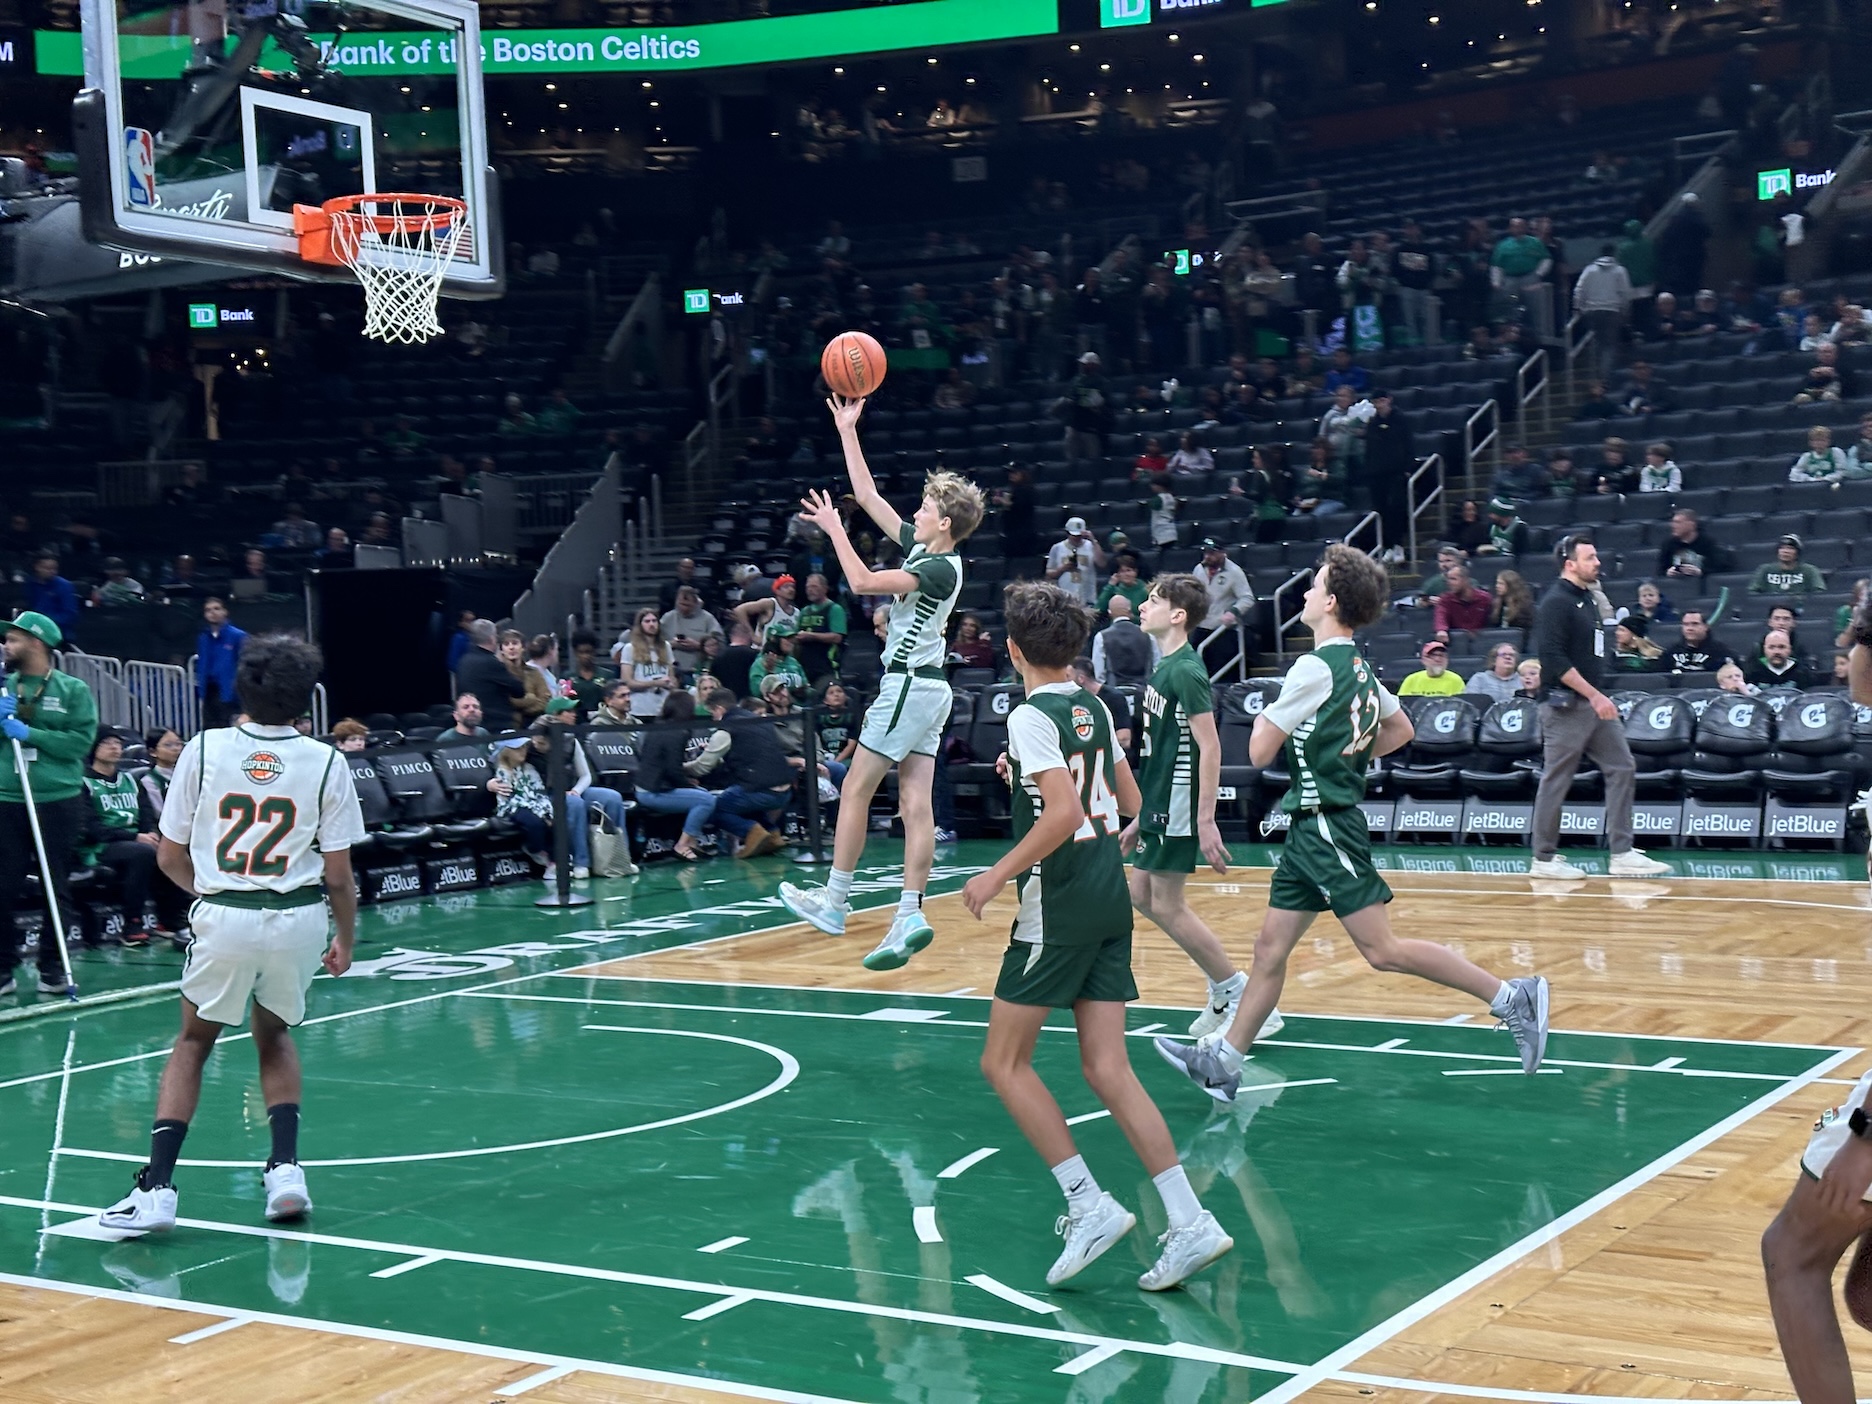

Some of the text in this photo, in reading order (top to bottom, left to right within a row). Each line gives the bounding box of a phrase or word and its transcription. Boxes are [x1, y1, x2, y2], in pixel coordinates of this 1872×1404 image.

[402, 38, 432, 64] of
[493, 37, 594, 63] Boston
[601, 34, 700, 61] Celtics
[1795, 169, 1837, 188] Bank
[712, 292, 744, 305] ank
[220, 309, 254, 321] Bank
[597, 745, 633, 756] PIMCO
[241, 759, 286, 774] HOPKINTON
[391, 761, 433, 776] PIMCO
[447, 757, 487, 770] PIMCO
[1398, 811, 1455, 830] jetBlue
[1466, 812, 1526, 832] jetBlue
[1560, 812, 1598, 830] Blue
[1632, 813, 1673, 830] Blue
[1686, 814, 1752, 835] jetBlue
[1770, 815, 1837, 836] jetBlue
[216, 792, 297, 877] 22
